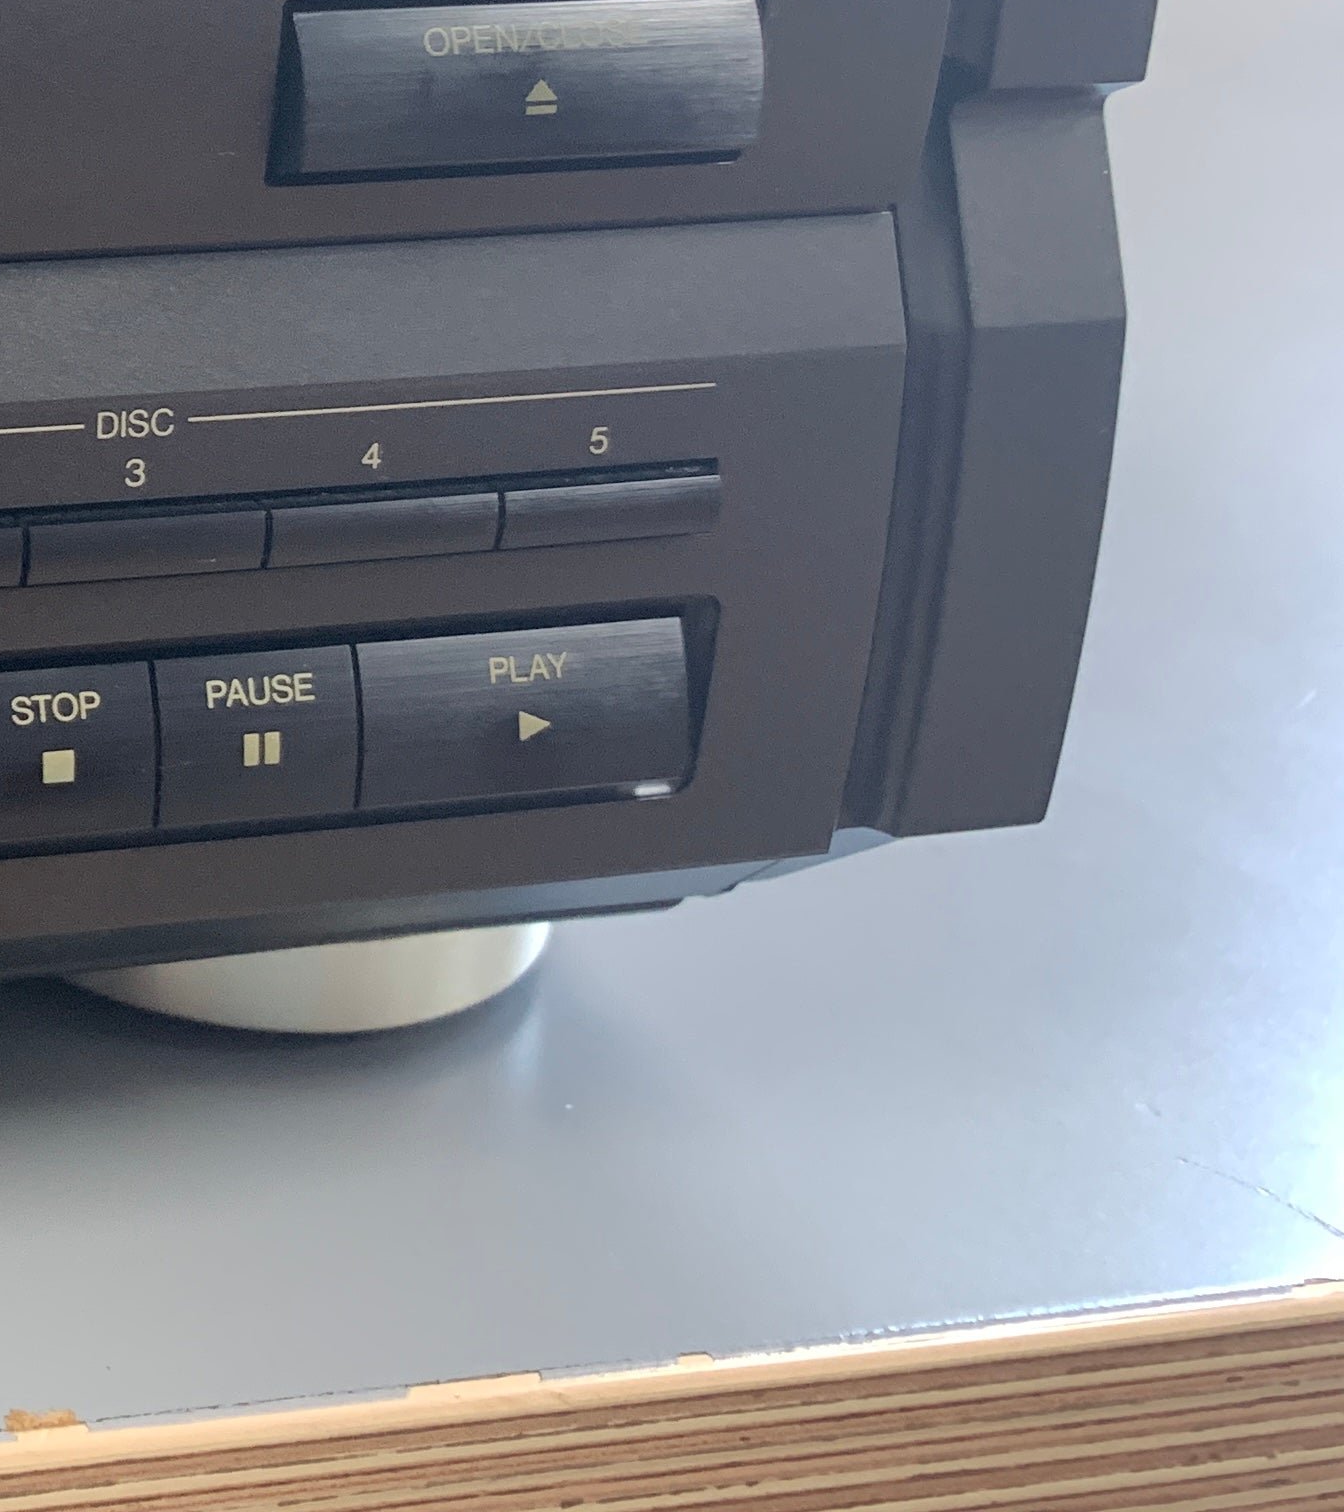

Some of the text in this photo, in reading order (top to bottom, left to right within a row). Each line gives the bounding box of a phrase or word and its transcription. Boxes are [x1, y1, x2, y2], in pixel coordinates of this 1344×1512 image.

[97, 409, 173, 438] DISC
[125, 459, 144, 486] 3
[362, 443, 380, 468] 4
[590, 427, 607, 453] 5
[490, 653, 565, 683] PLAY
[207, 673, 314, 708] PAUSE
[11, 692, 99, 725] STOP
